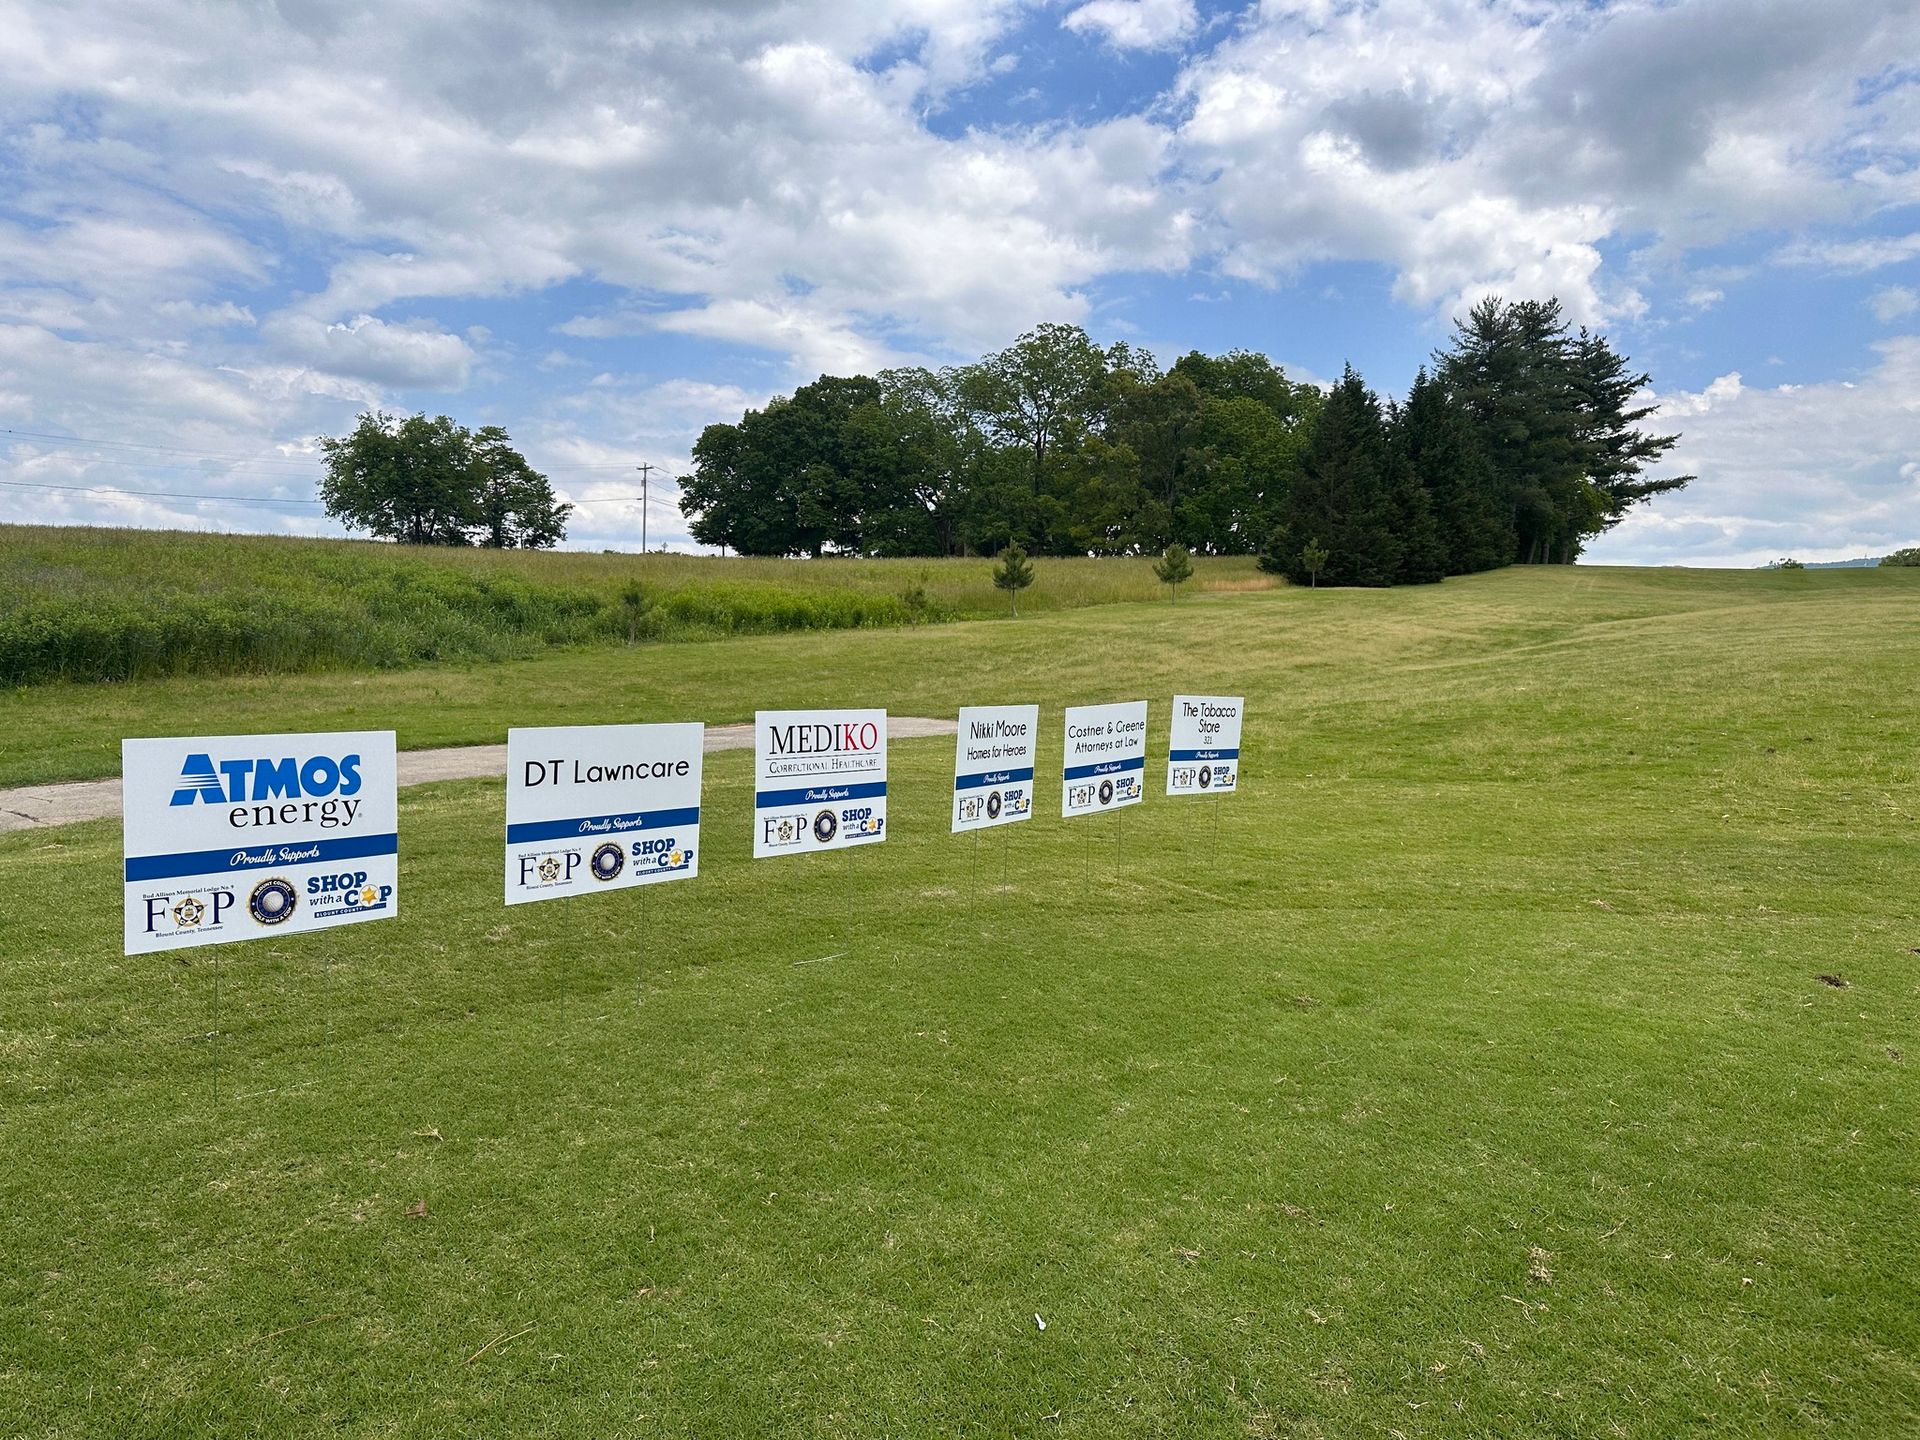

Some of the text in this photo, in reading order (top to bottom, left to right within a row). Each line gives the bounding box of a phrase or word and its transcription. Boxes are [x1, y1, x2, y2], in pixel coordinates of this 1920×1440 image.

[1183, 702, 1236, 718] The Tobacco
[970, 720, 1027, 740] Nikki Moore
[1068, 720, 1145, 739] Costner & Greene
[1198, 718, 1220, 733] Store
[769, 722, 878, 754] MEDIKO
[1075, 736, 1138, 754] Attorneys at Law
[967, 743, 1026, 761] Homes for Heroes
[169, 753, 362, 807] ATMOS
[525, 759, 690, 787] DT Lawncare
[1116, 777, 1135, 789] SHOP
[1004, 789, 1023, 801] SHOP
[229, 798, 361, 829] energy
[842, 807, 872, 822] SHOP
[579, 816, 643, 832] Proudly Supports
[230, 844, 320, 866] Proudly Supports
[632, 838, 675, 856] SHOP
[633, 857, 651, 866] with
[273, 880, 291, 891] COUNTY
[307, 871, 367, 894] SHOP
[176, 887, 203, 896] Memorial
[309, 895, 334, 906] with
[335, 895, 342, 903] a
[316, 910, 339, 918] BLOUNT
[197, 925, 224, 933] Tennessee
